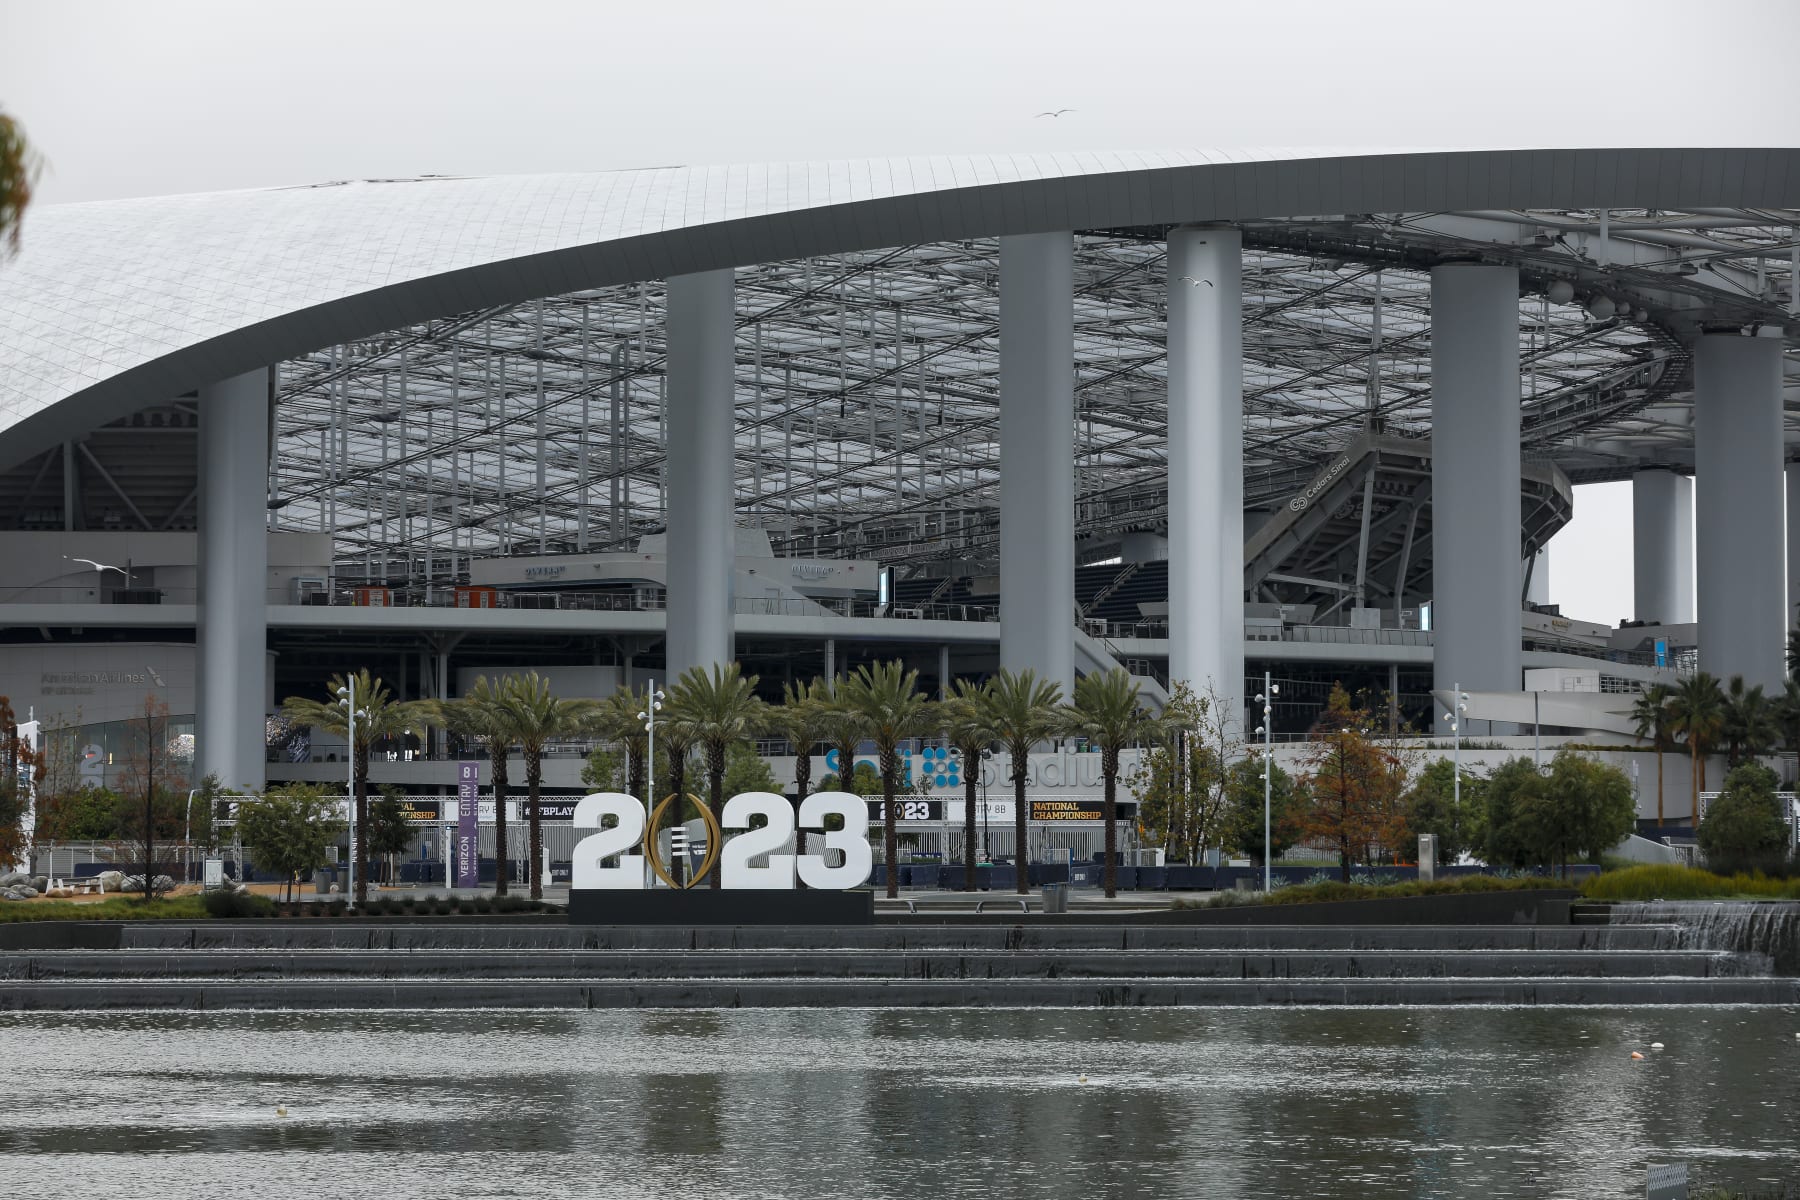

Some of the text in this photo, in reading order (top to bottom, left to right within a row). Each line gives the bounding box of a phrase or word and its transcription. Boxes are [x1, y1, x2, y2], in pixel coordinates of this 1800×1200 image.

[1306, 456, 1350, 498] Cedars Sinai
[101, 672, 145, 684] Airlines
[461, 784, 471, 817] ENTRY
[1033, 802, 1079, 811] NATIONAL
[1033, 811, 1102, 820] CHAMPIONSHIP
[460, 836, 469, 878] VERIZON
